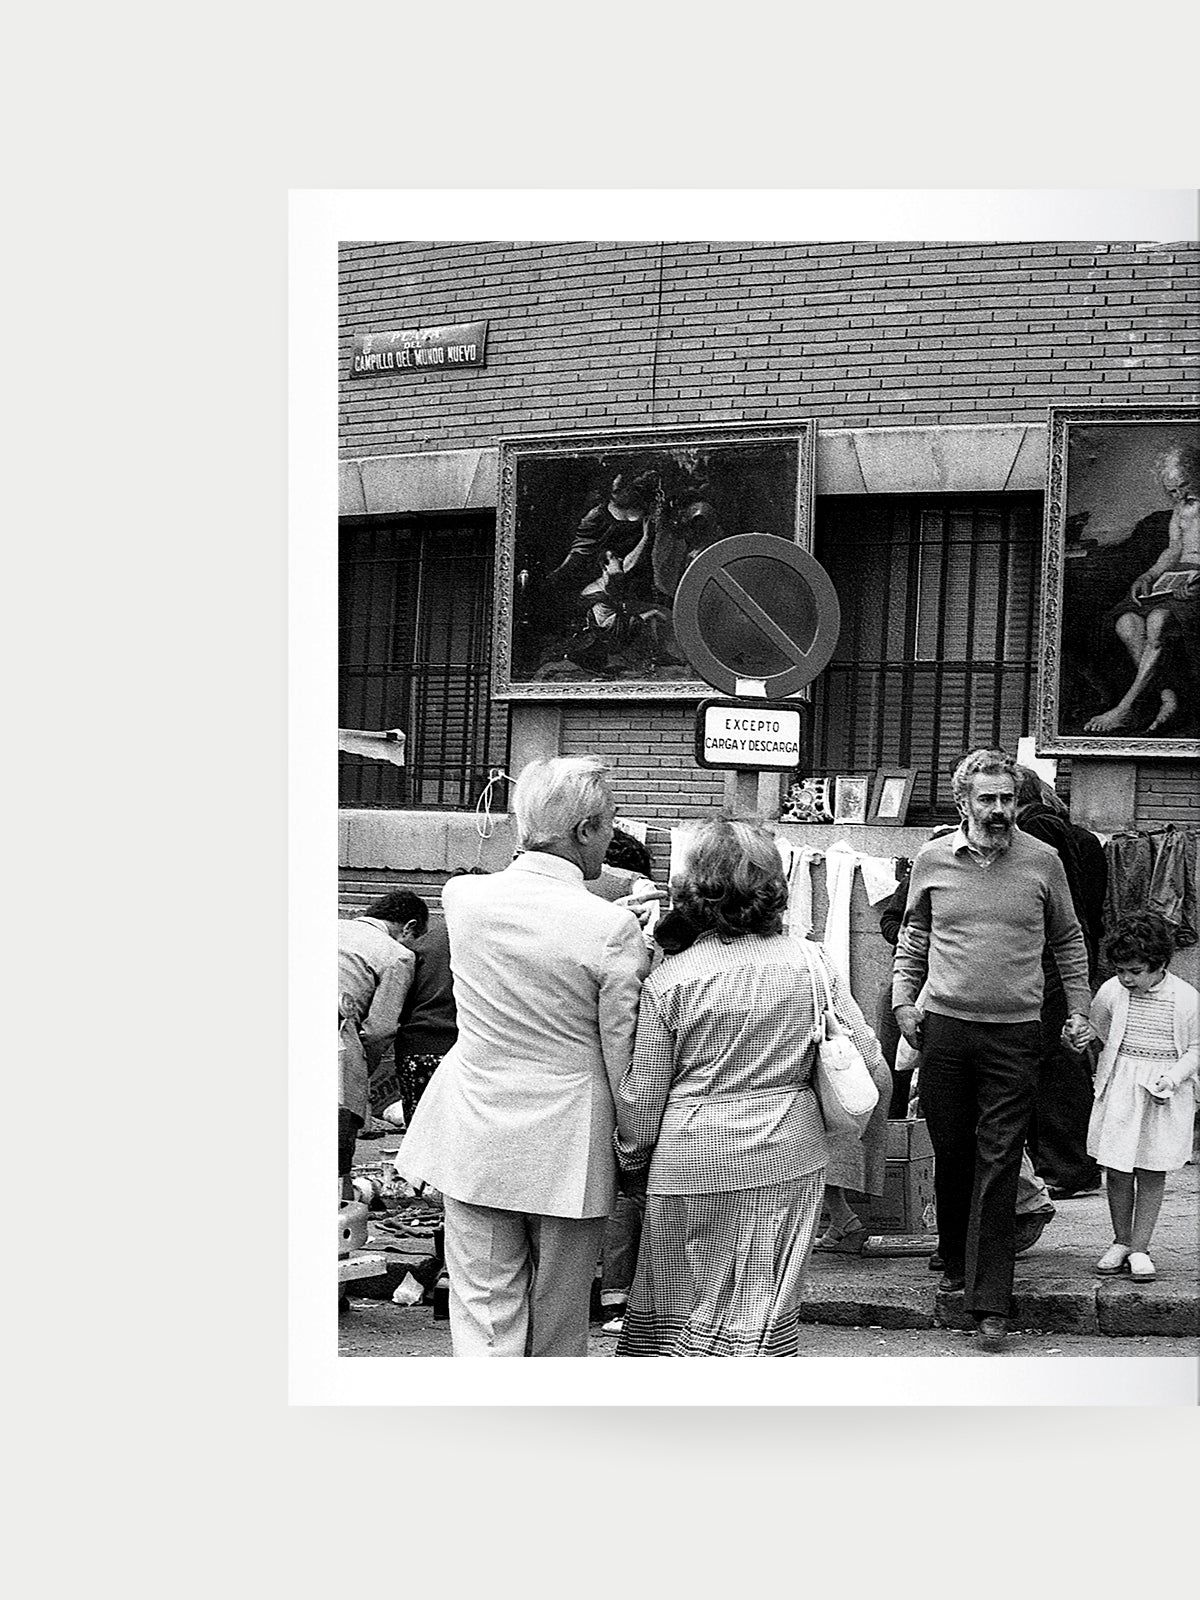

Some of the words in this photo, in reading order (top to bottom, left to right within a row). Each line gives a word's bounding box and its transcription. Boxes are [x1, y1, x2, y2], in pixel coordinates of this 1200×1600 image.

[390, 331, 440, 343] PLAZA
[404, 341, 421, 349] DEL
[355, 352, 394, 371] CAMPILLO
[396, 350, 413, 367] DEL
[414, 347, 443, 365] MUNDO
[447, 344, 477, 362] NUEVO
[725, 718, 780, 733] EXCEPTO
[705, 737, 739, 750] CARGA
[740, 740, 746, 750] Y
[748, 739, 799, 753] DESCARGA
